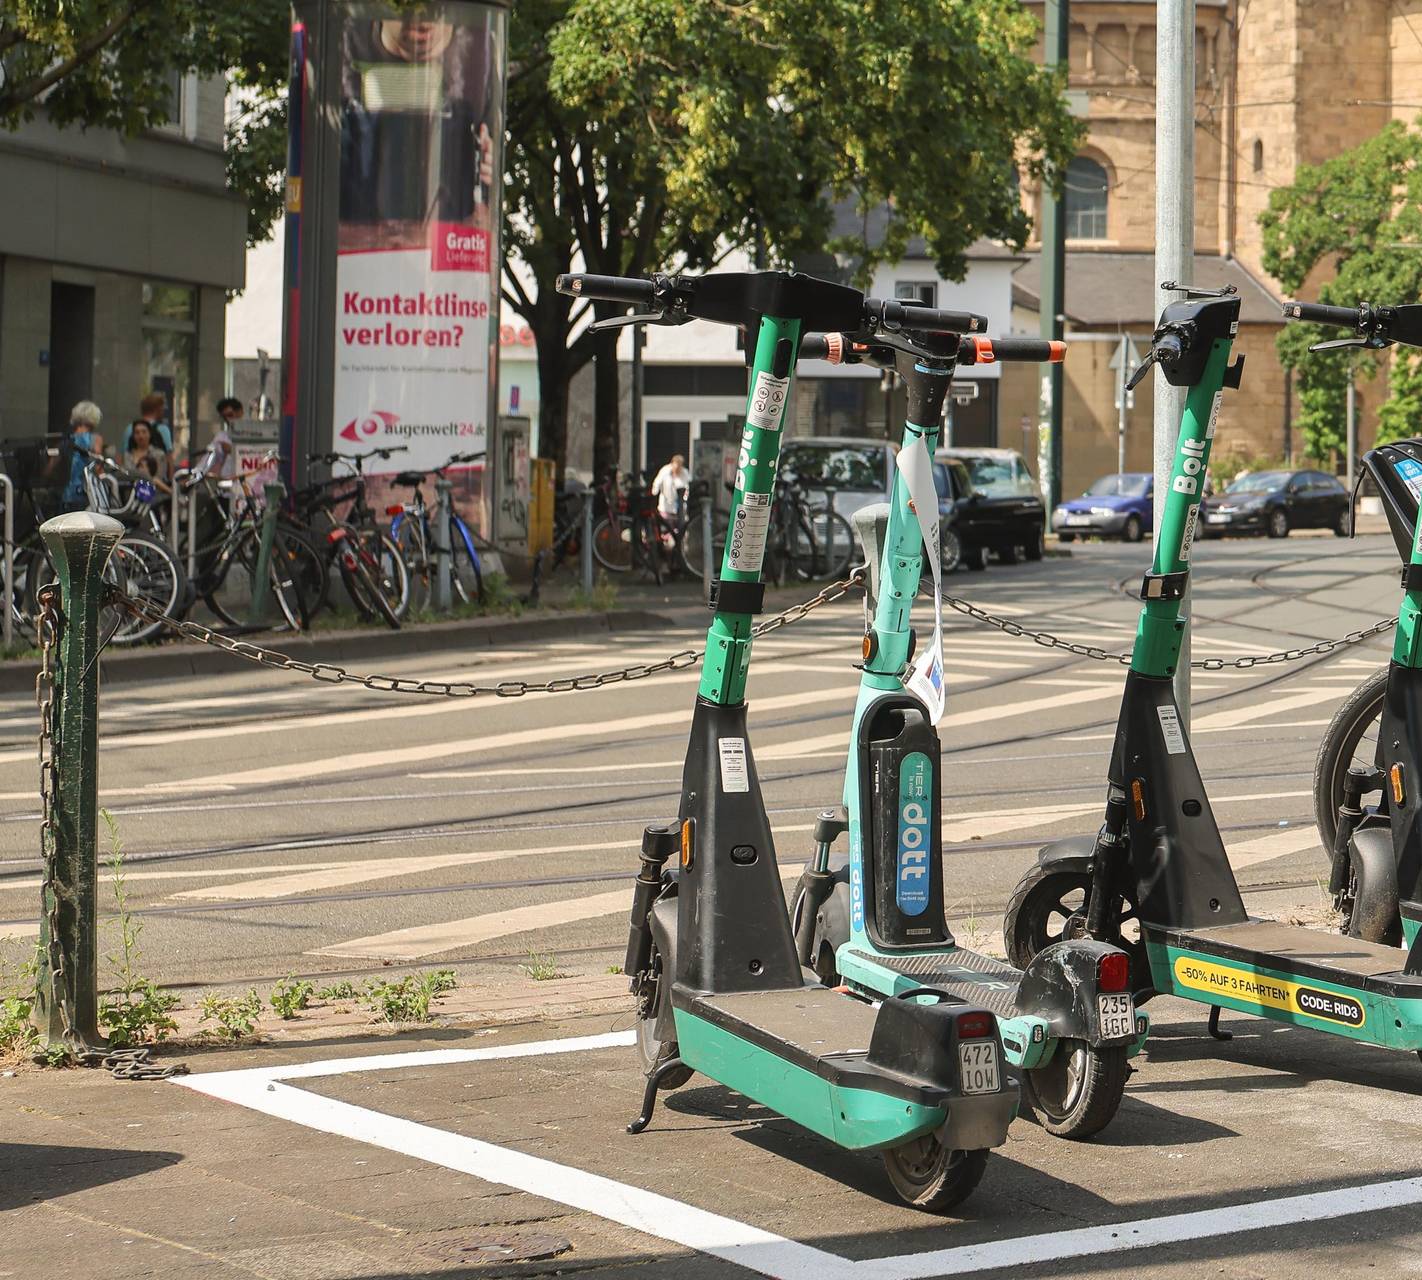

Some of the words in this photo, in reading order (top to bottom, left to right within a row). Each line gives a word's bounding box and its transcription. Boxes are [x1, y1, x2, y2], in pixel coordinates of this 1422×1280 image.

[446, 232, 487, 251] Gratis
[343, 292, 488, 318] Kontaktlinse
[342, 322, 464, 347] verloren?
[384, 422, 485, 439] augenwelt24.de
[1173, 439, 1206, 495] Bolt
[915, 760, 924, 797] TIER
[902, 803, 928, 881] dott
[853, 869, 862, 922] dott
[1209, 973, 1230, 987] AUF
[1231, 978, 1238, 989] 3
[1101, 996, 1128, 1014] 235
[1301, 994, 1333, 1013] CODE:
[1334, 1001, 1358, 1019] RID3
[963, 1045, 993, 1066] 472
